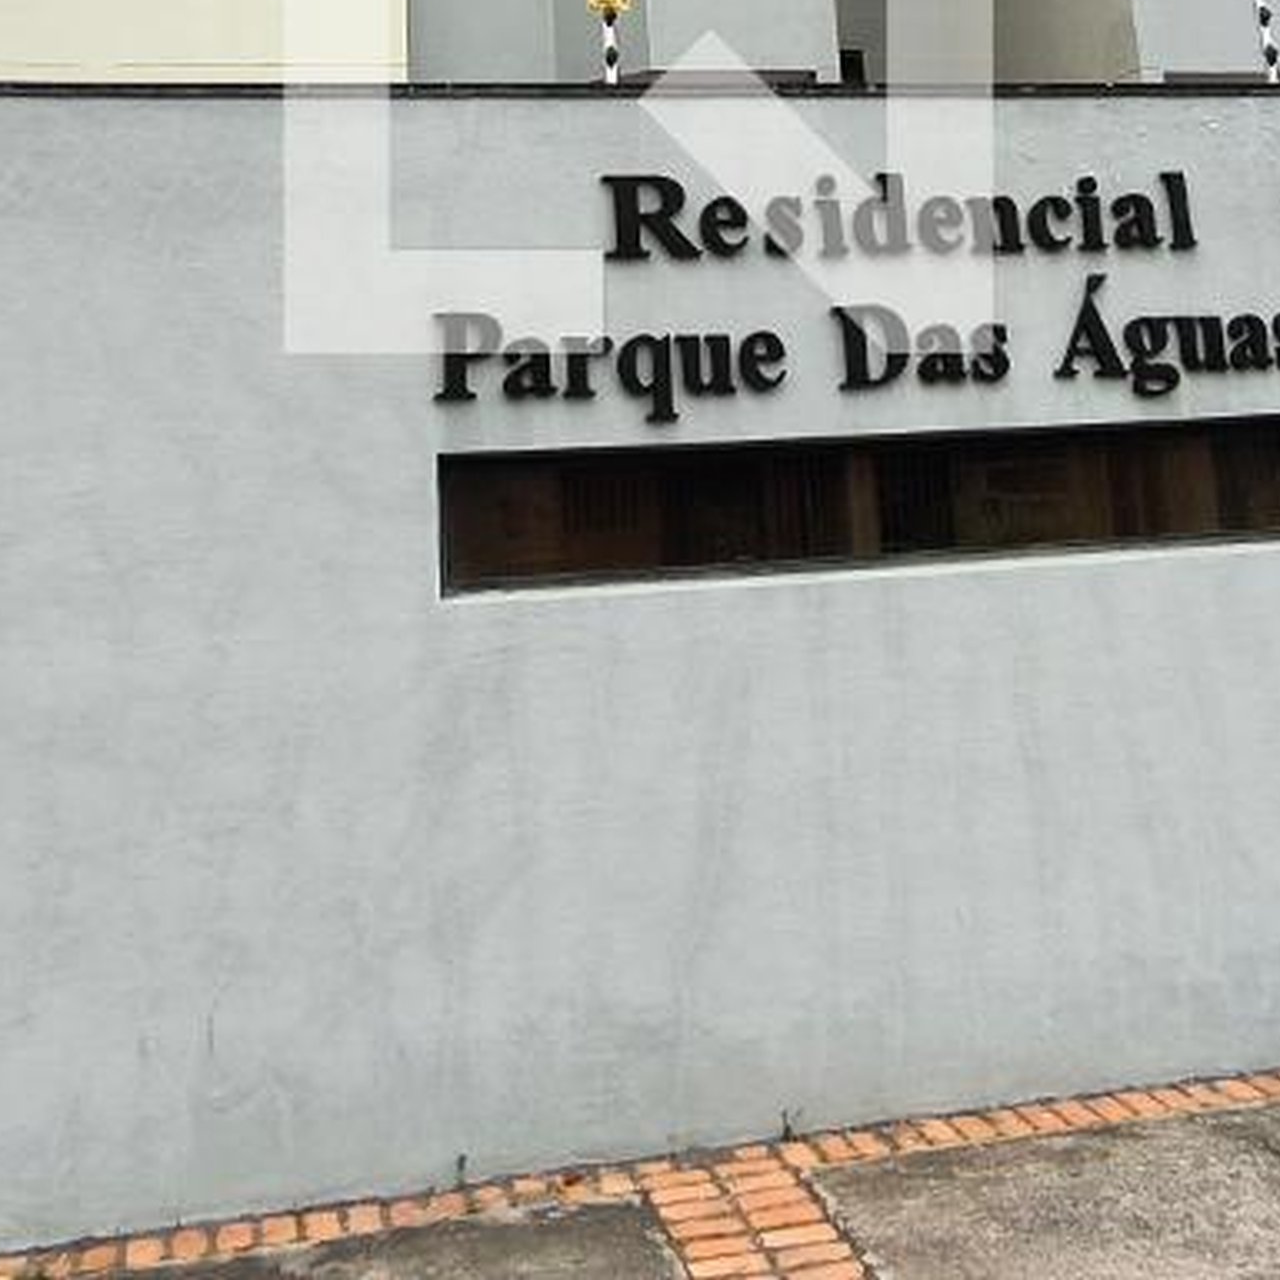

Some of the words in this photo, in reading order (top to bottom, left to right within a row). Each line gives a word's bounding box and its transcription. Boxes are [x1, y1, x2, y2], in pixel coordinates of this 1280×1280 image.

[601, 171, 1198, 261] Residencial
[433, 313, 788, 423] Parque
[829, 305, 1010, 391] Das
